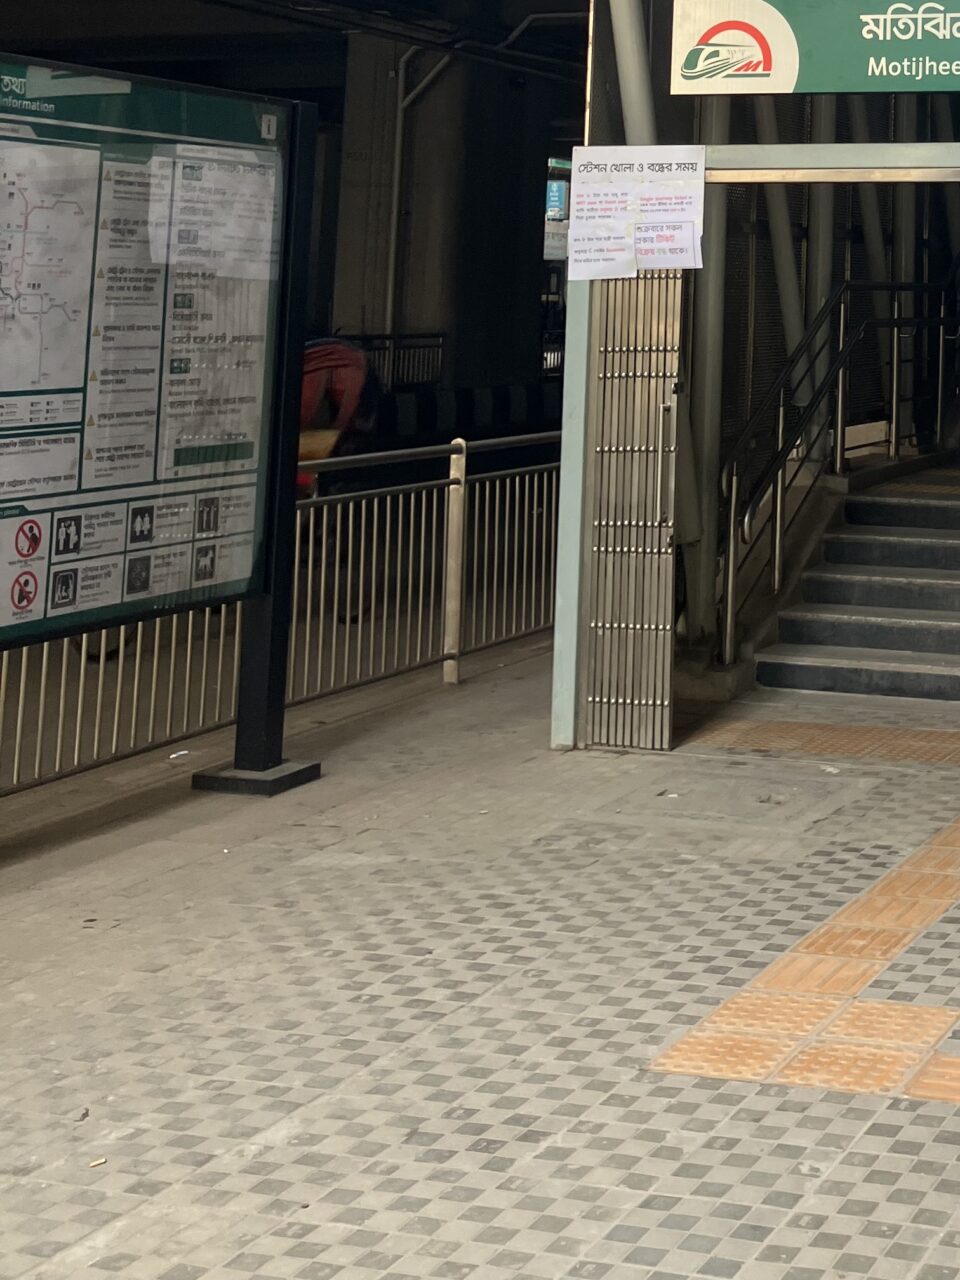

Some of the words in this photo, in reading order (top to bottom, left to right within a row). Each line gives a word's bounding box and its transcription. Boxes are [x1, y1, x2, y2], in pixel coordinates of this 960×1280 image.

[578, 161, 607, 173] স্টেশন
[610, 163, 634, 173] খোলা
[636, 163, 644, 173] ও
[647, 162, 672, 173] বন্ধের
[674, 161, 698, 172] সময়
